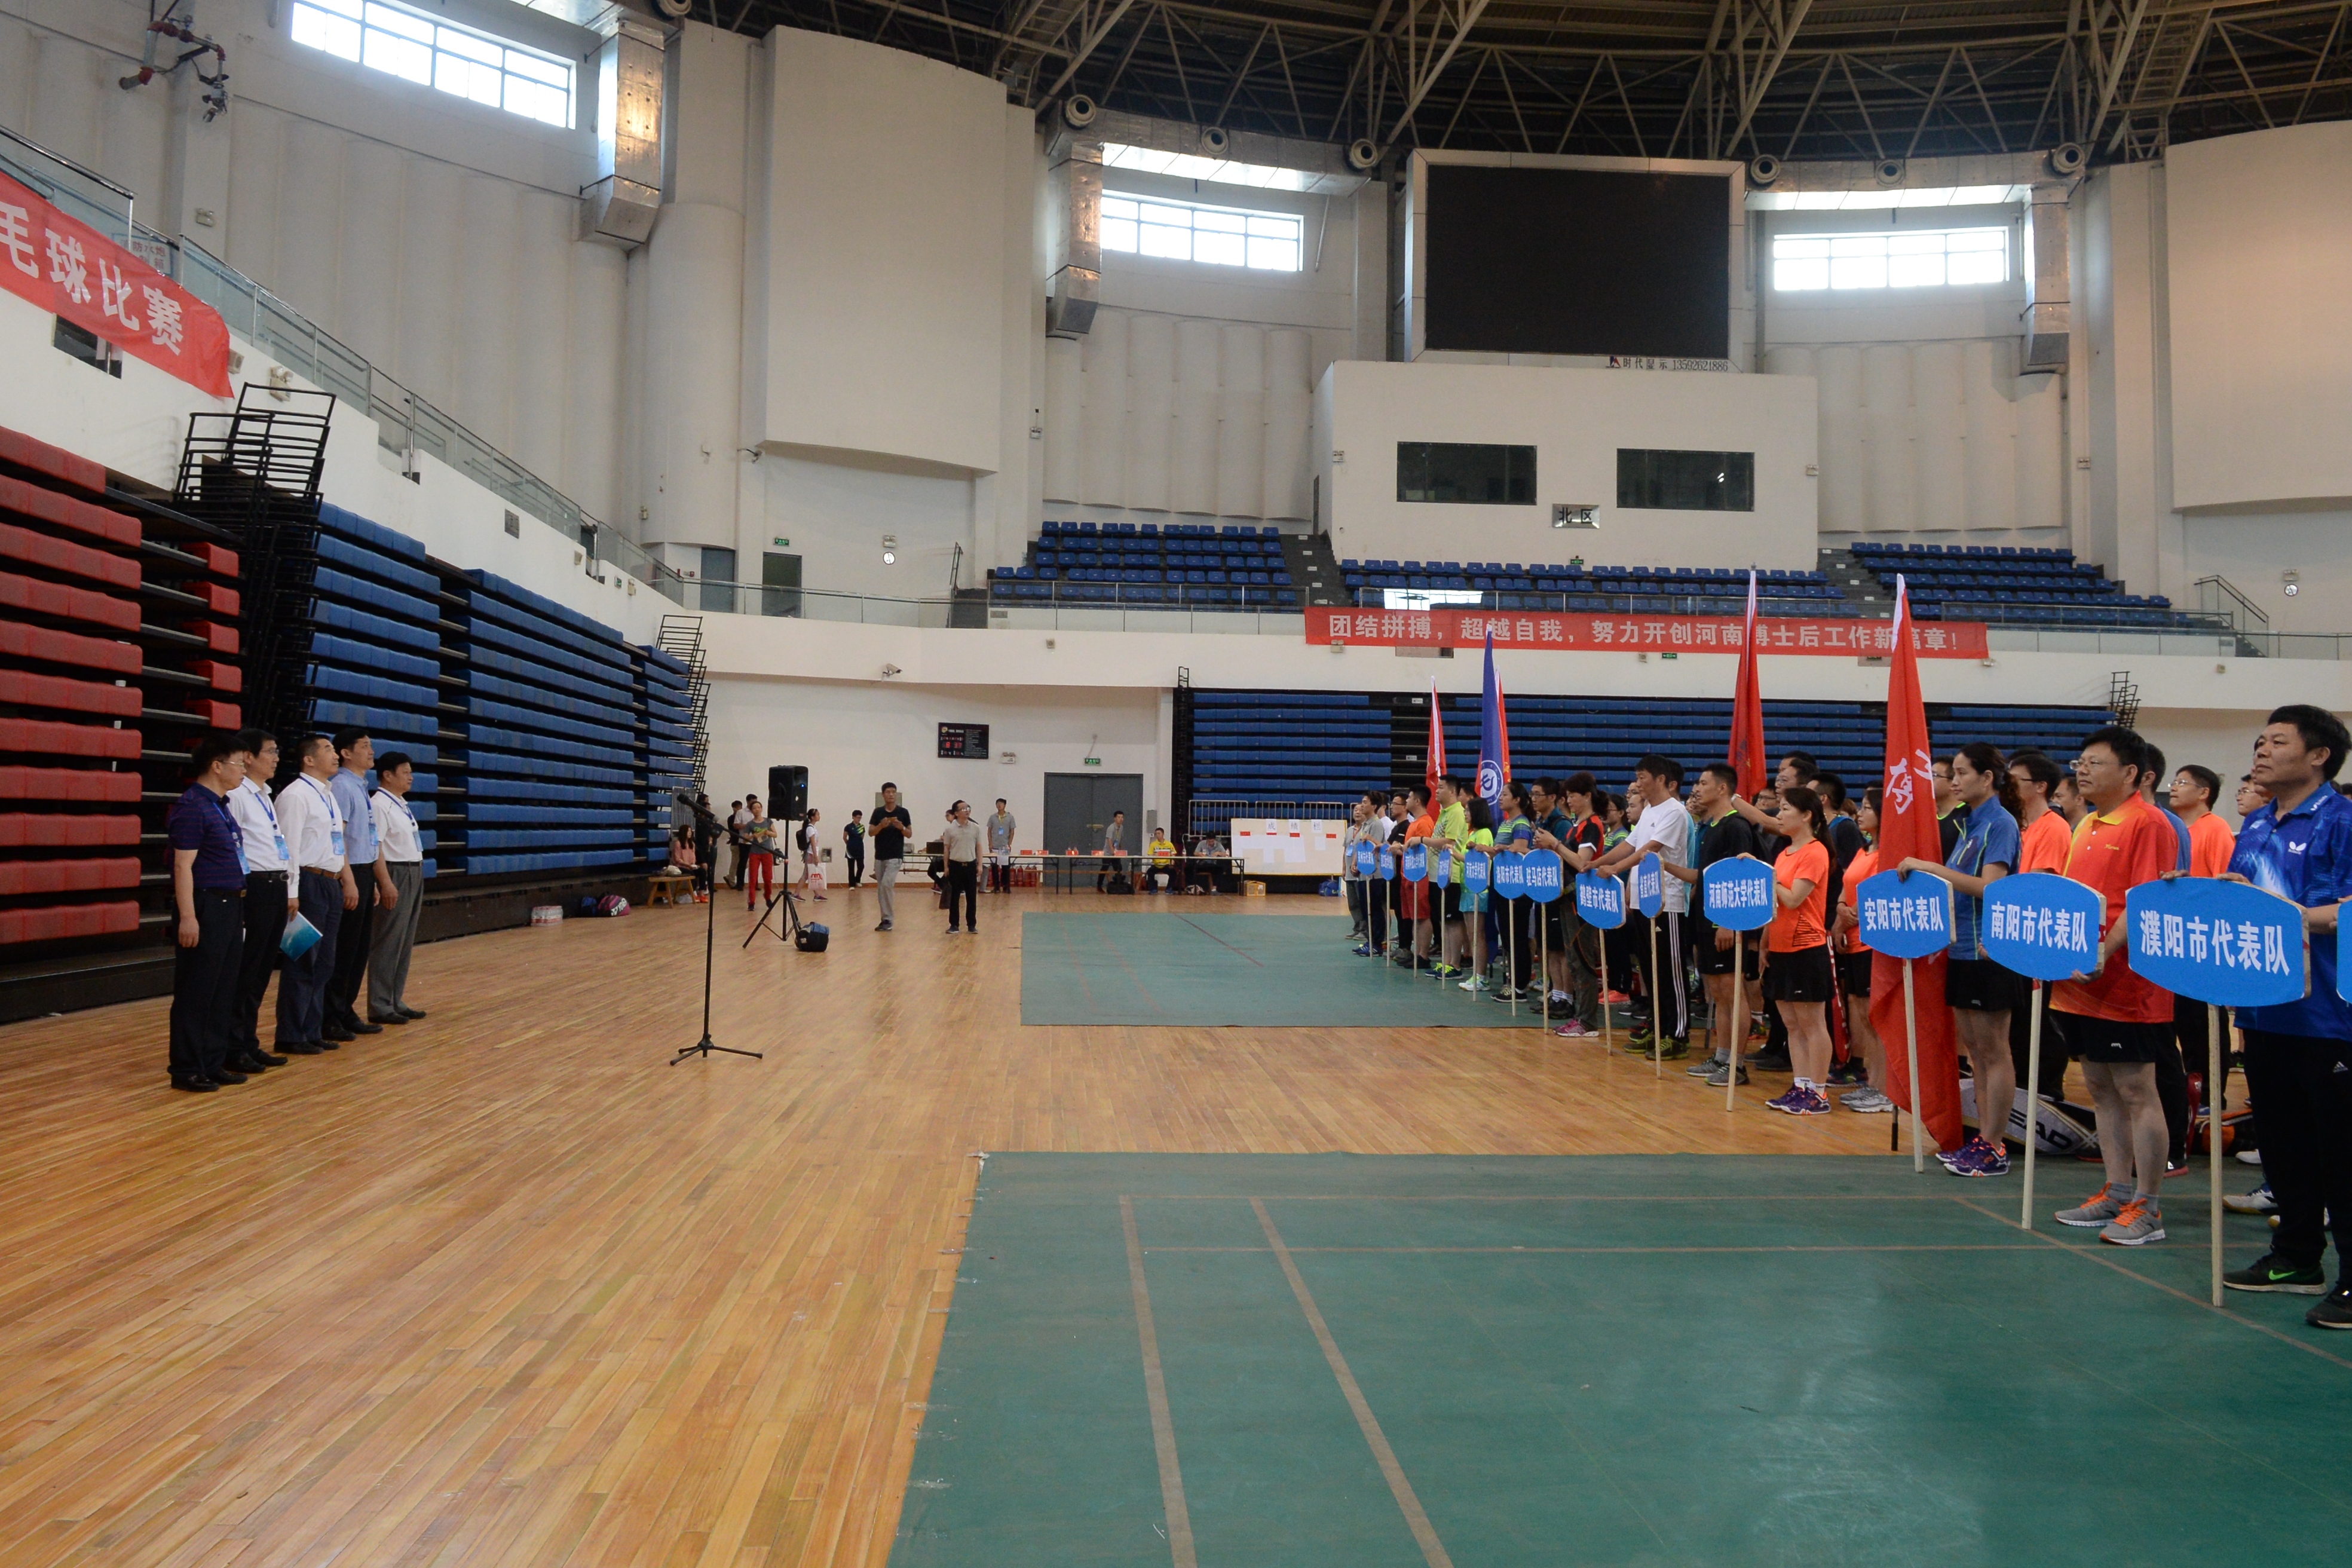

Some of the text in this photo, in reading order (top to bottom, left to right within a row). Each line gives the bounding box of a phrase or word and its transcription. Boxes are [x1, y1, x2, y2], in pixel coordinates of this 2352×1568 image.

[1623, 357, 1668, 370] 时代显示
[1558, 507, 1593, 524] 北区
[1496, 865, 1524, 884] 洛阳市代表队
[1526, 866, 1558, 887] 驻马店代表队
[1579, 884, 1619, 913] 鹤壁市代表队
[1709, 878, 1768, 909] 河南师范大学代表队
[1864, 896, 1944, 932] 安阳市代表队
[1991, 901, 2088, 953] 南阳市代表队
[2139, 909, 2290, 976] 濮阳市代表队
